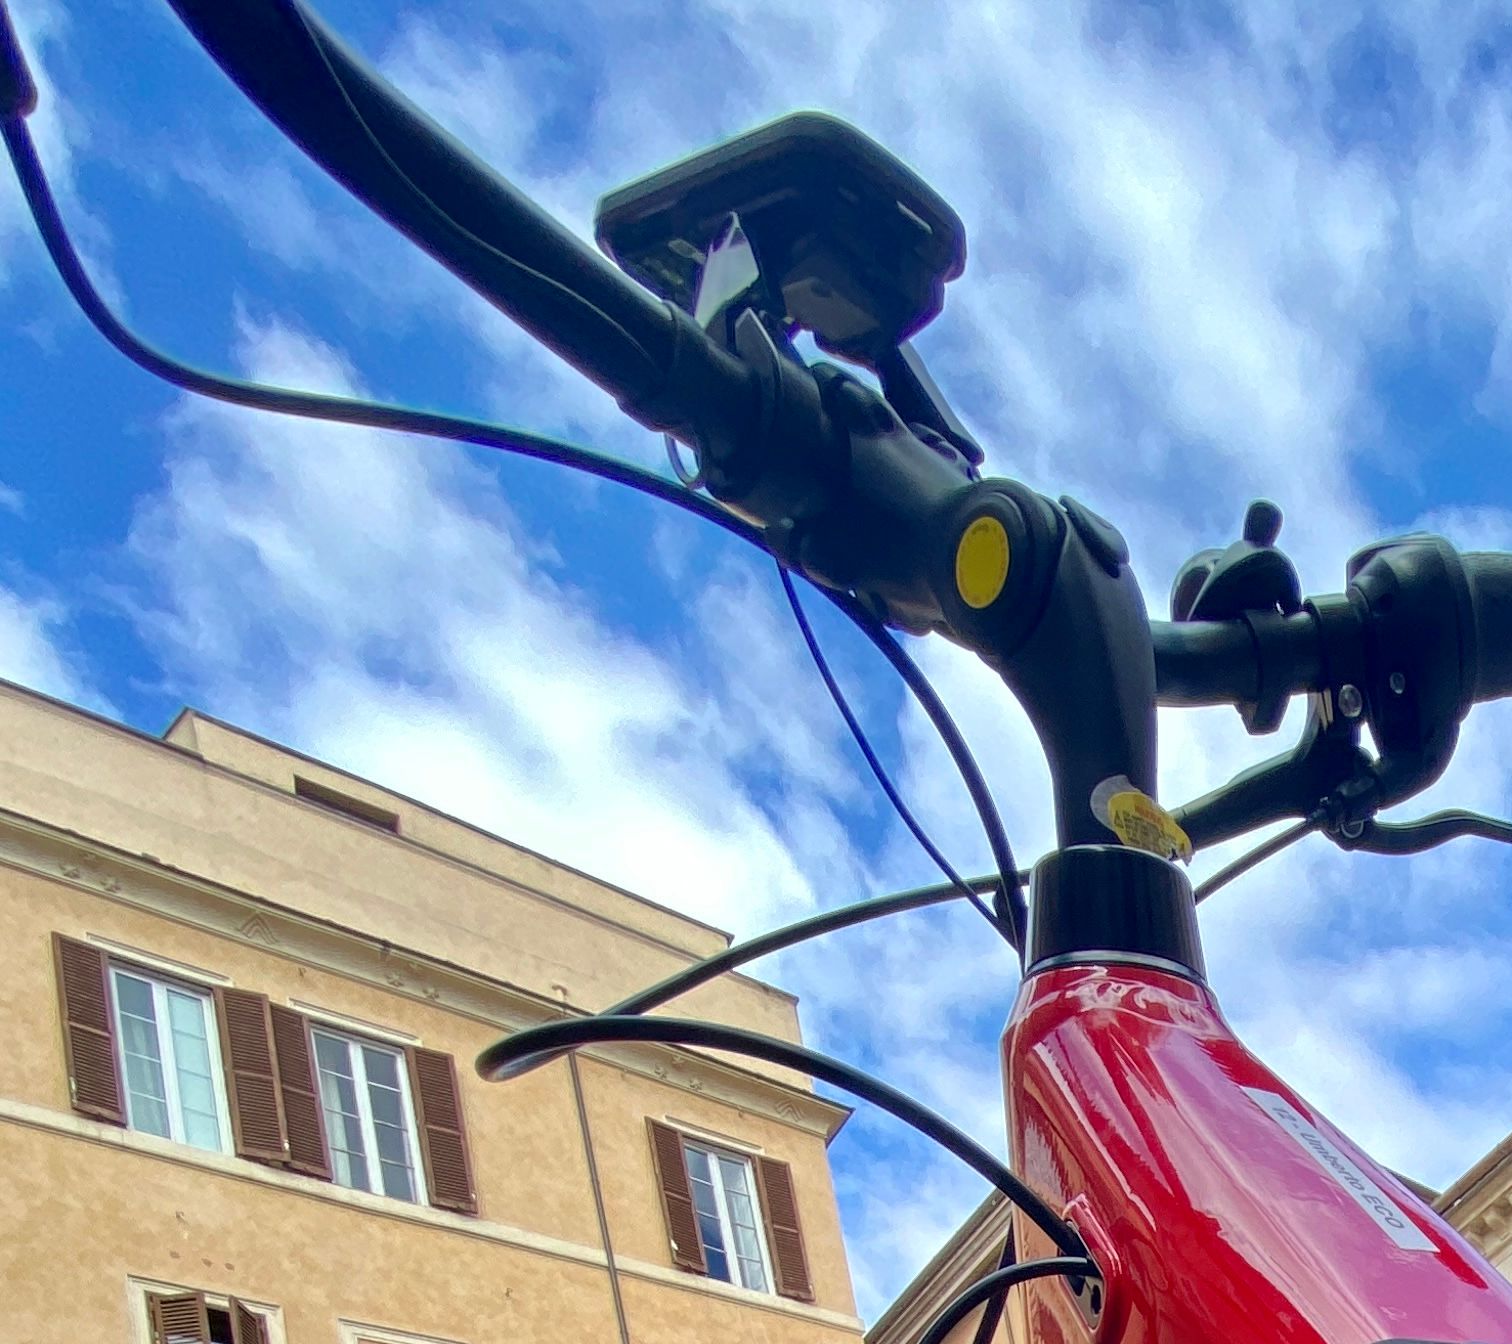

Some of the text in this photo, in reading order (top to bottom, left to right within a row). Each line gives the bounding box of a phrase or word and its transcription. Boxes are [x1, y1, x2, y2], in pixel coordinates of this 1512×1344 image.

[1272, 1106, 1297, 1122] 12
[1300, 1132, 1365, 1191] Umberto
[1361, 1193, 1405, 1229] ECO
